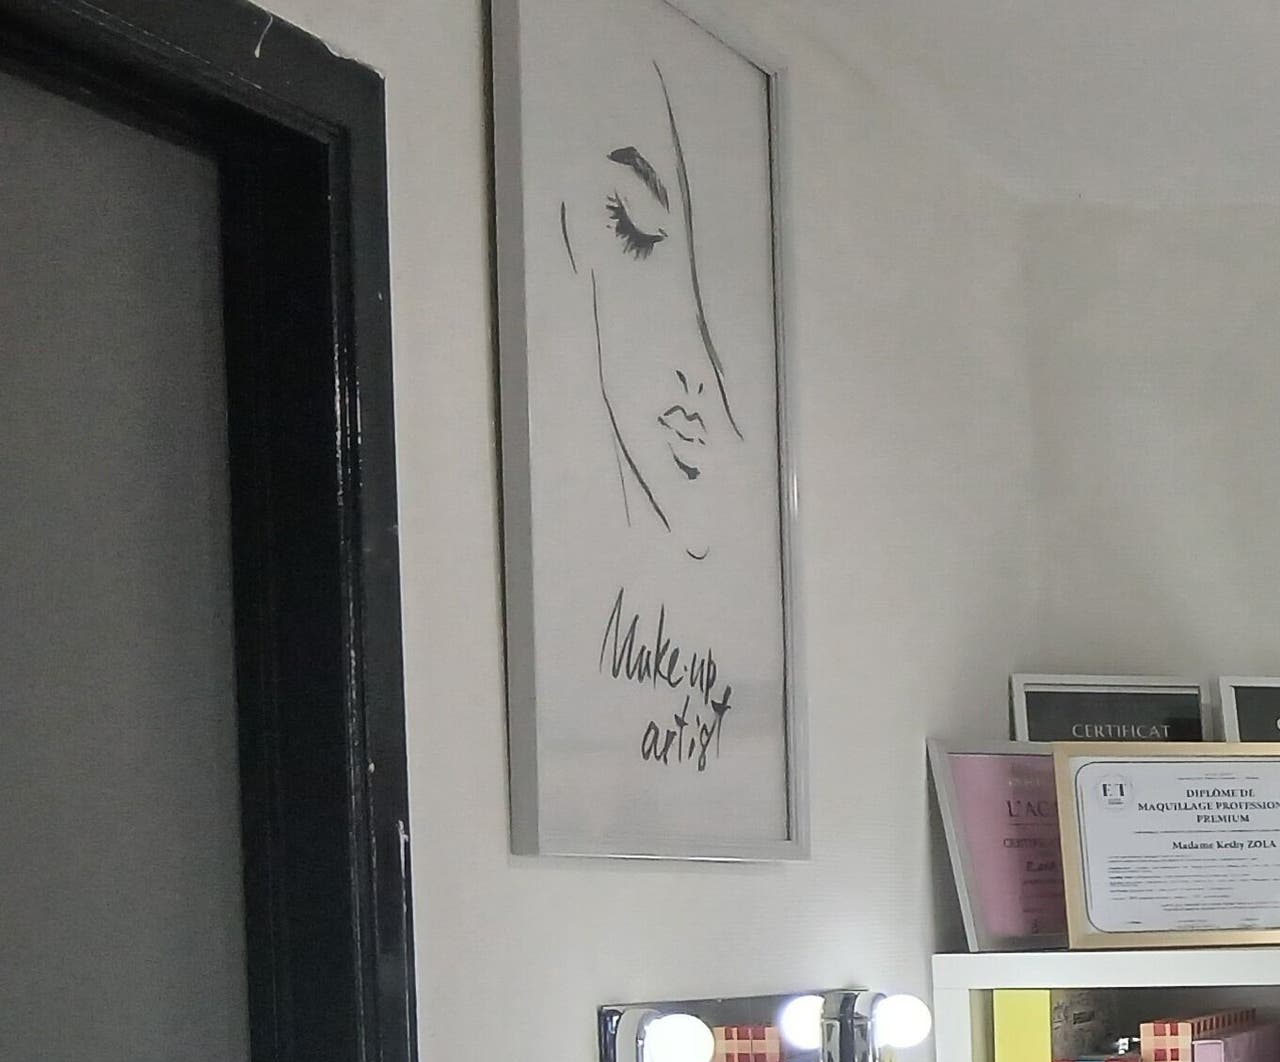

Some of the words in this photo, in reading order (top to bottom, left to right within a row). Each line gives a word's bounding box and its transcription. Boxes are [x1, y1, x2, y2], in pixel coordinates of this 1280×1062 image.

[641, 686, 732, 772] artist
[1072, 723, 1171, 739] CERTIFICAT
[1138, 801, 1213, 811] MAQUILLAGE
[1196, 814, 1250, 824] PREMIUM
[1172, 840, 1214, 850] Madame
[1247, 840, 1277, 850] ZOLA
